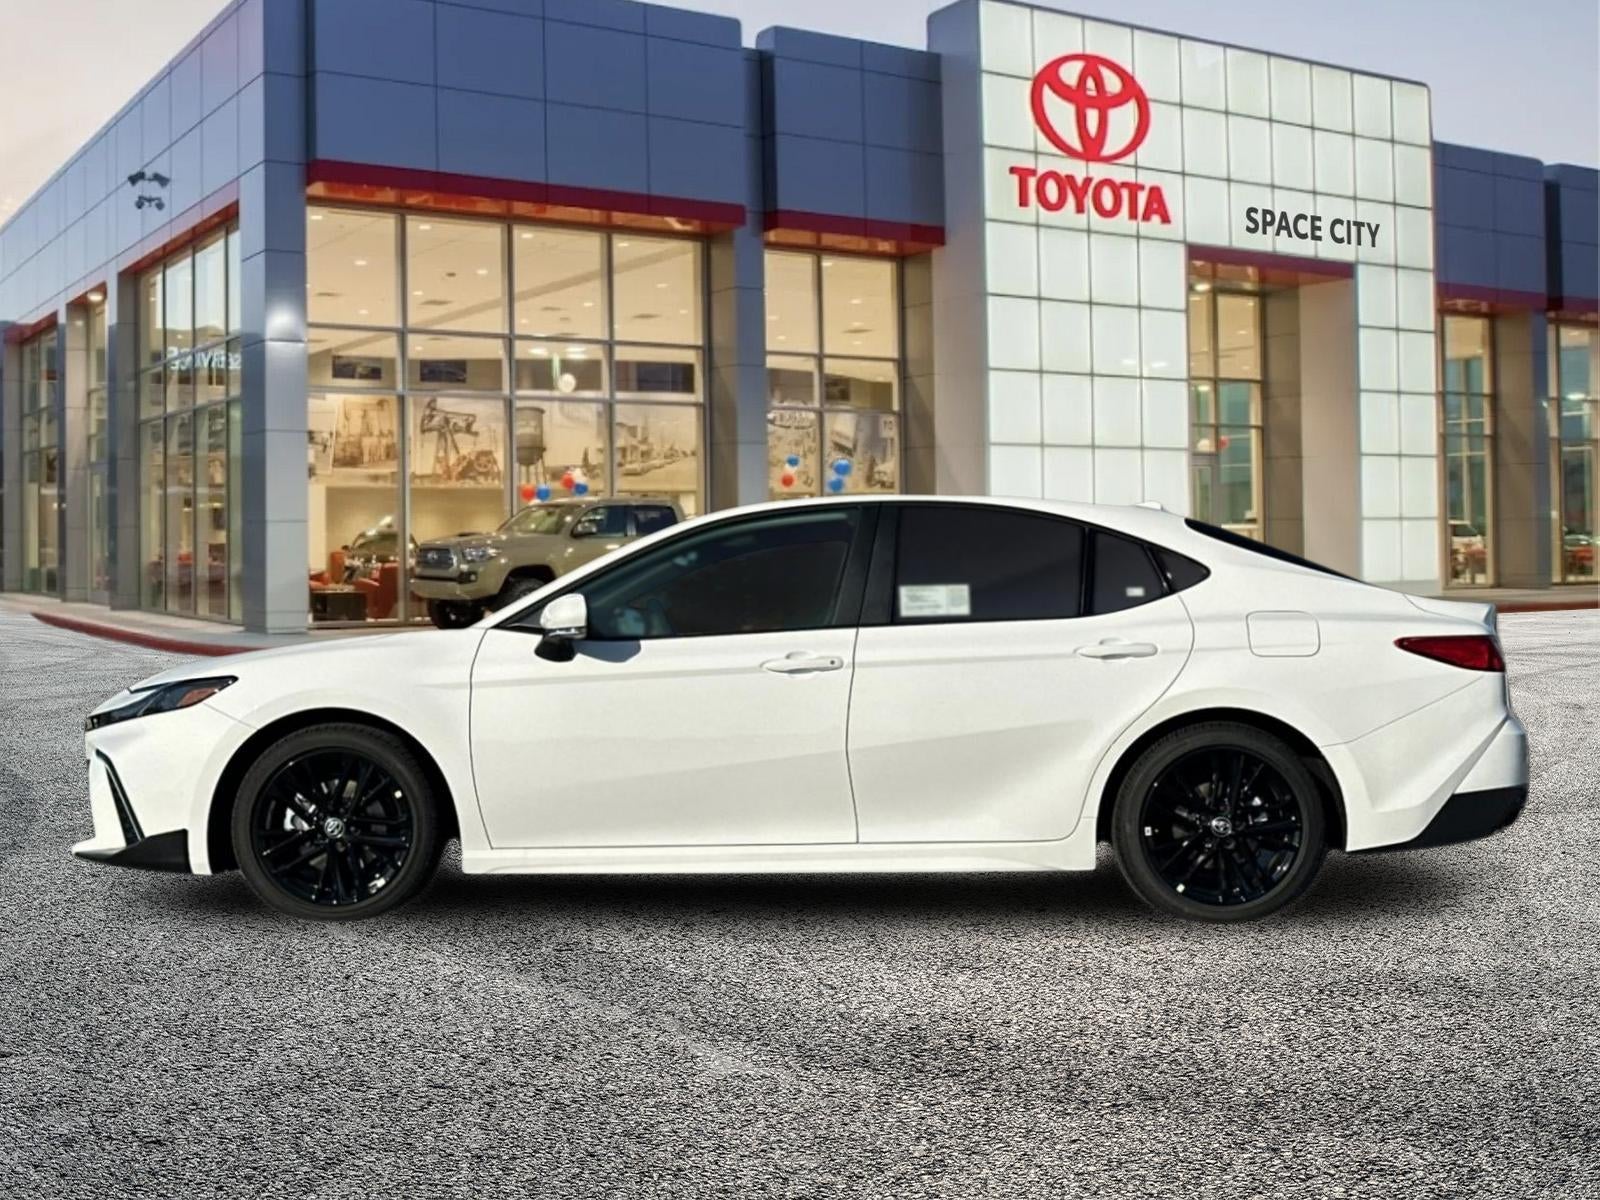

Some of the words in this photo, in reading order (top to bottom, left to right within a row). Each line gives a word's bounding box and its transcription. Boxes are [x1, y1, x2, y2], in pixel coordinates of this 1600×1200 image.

[1009, 166, 1171, 224] TOYOTA
[1245, 206, 1322, 241] SPACE
[1329, 217, 1381, 248] CITY
